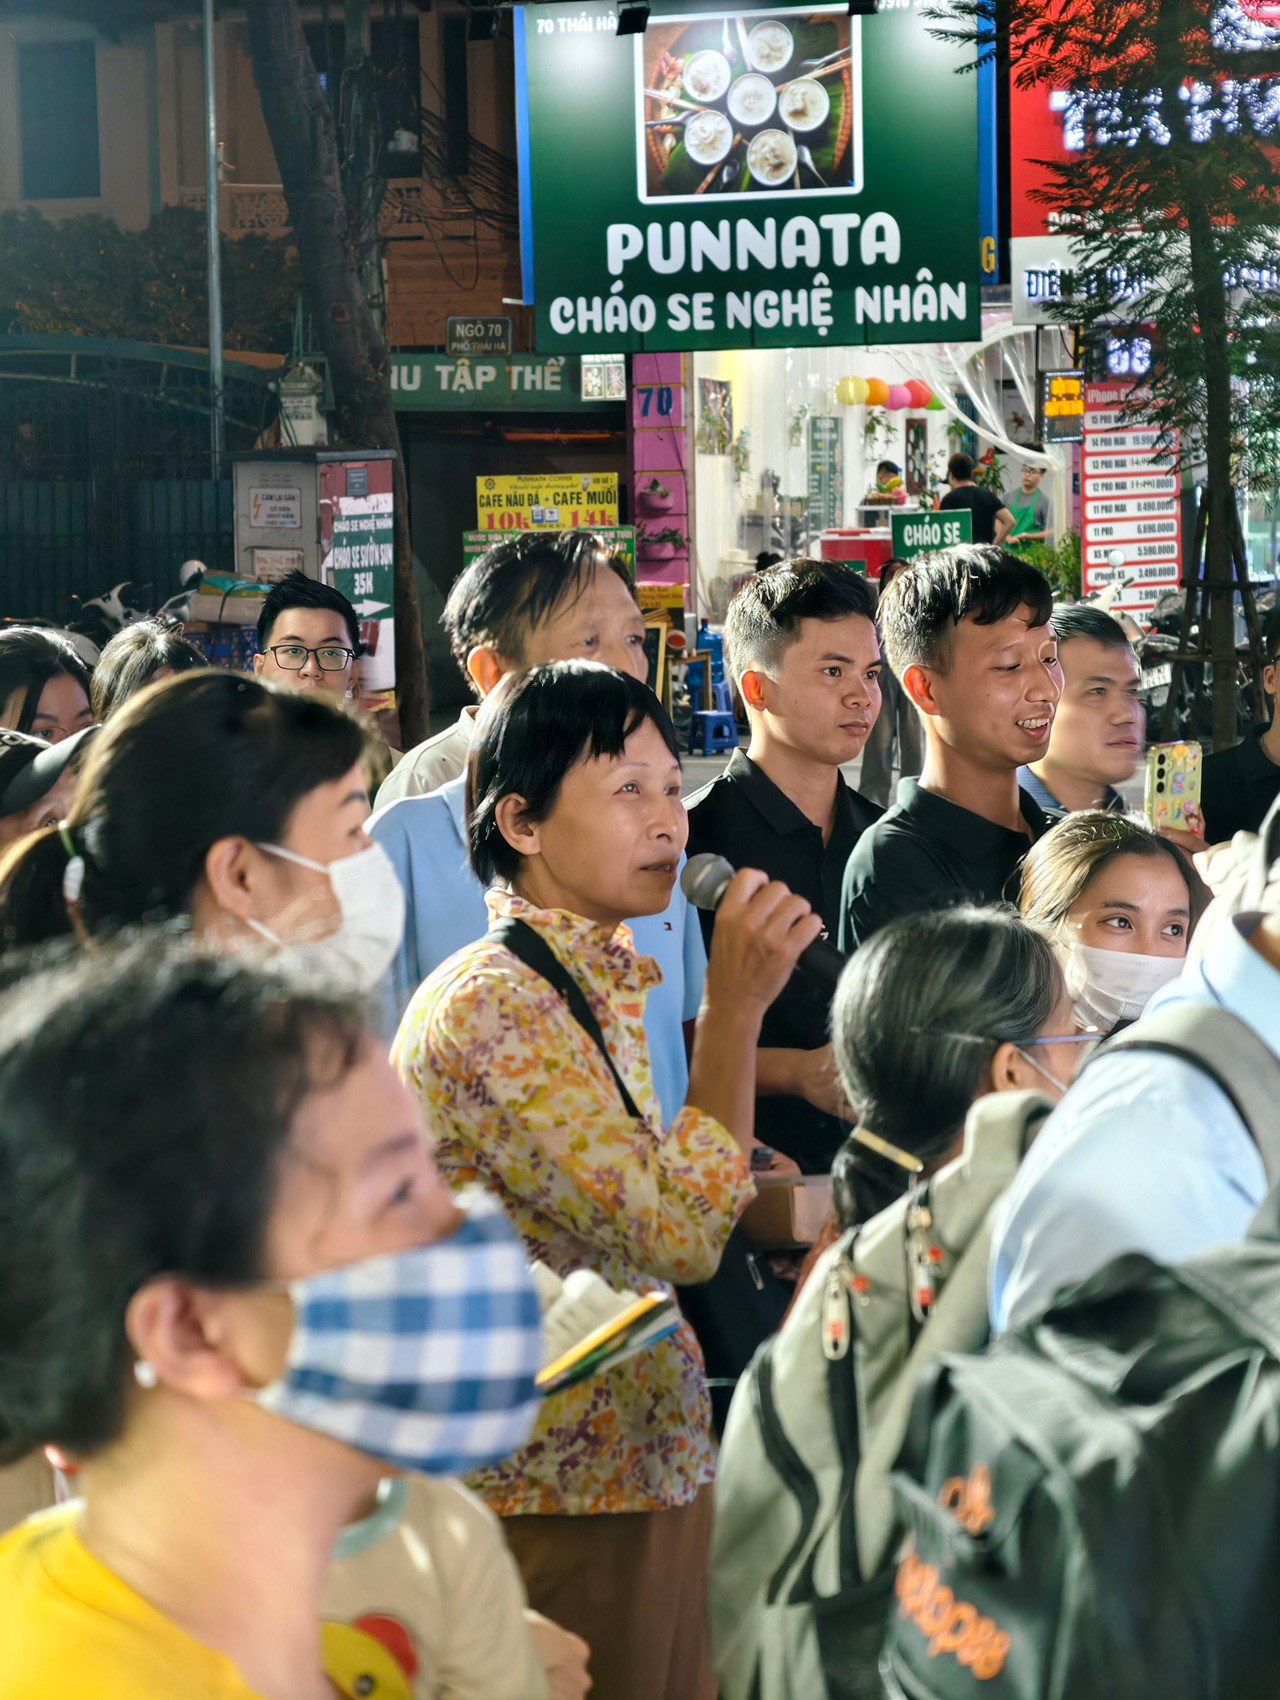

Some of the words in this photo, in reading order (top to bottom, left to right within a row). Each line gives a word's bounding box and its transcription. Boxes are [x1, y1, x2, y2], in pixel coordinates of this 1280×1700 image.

[536, 19, 554, 33] 70
[557, 11, 593, 32] THÁI
[596, 10, 618, 31] HÀ
[606, 211, 902, 276] PUNNATA
[549, 279, 656, 335] CHÁO
[667, 291, 715, 331] SE
[726, 272, 834, 337] NGHỆ
[855, 266, 967, 325] NHÂN
[455, 320, 485, 337] NGÕ
[488, 323, 502, 337] 70
[435, 357, 497, 393] TẬP
[506, 356, 567, 391] THỂ
[637, 386, 673, 417] 70
[1100, 437, 1112, 447] PRO
[1101, 459, 1113, 469] PRO
[1101, 481, 1113, 491] PRO
[479, 494, 503, 508] CAFE
[527, 491, 540, 506] ĐÁ
[553, 491, 582, 506] CAFE
[1101, 504, 1113, 514] PRO
[333, 515, 350, 533] CHÁO
[351, 519, 358, 532] SE
[486, 511, 531, 530] 10k
[570, 509, 615, 528] 14k
[903, 515, 941, 547] CHÁO
[944, 521, 961, 544] SE
[1101, 526, 1113, 536] PRO
[334, 537, 351, 570] CHÁO
[352, 545, 360, 568] SE
[354, 571, 373, 595] 35K
